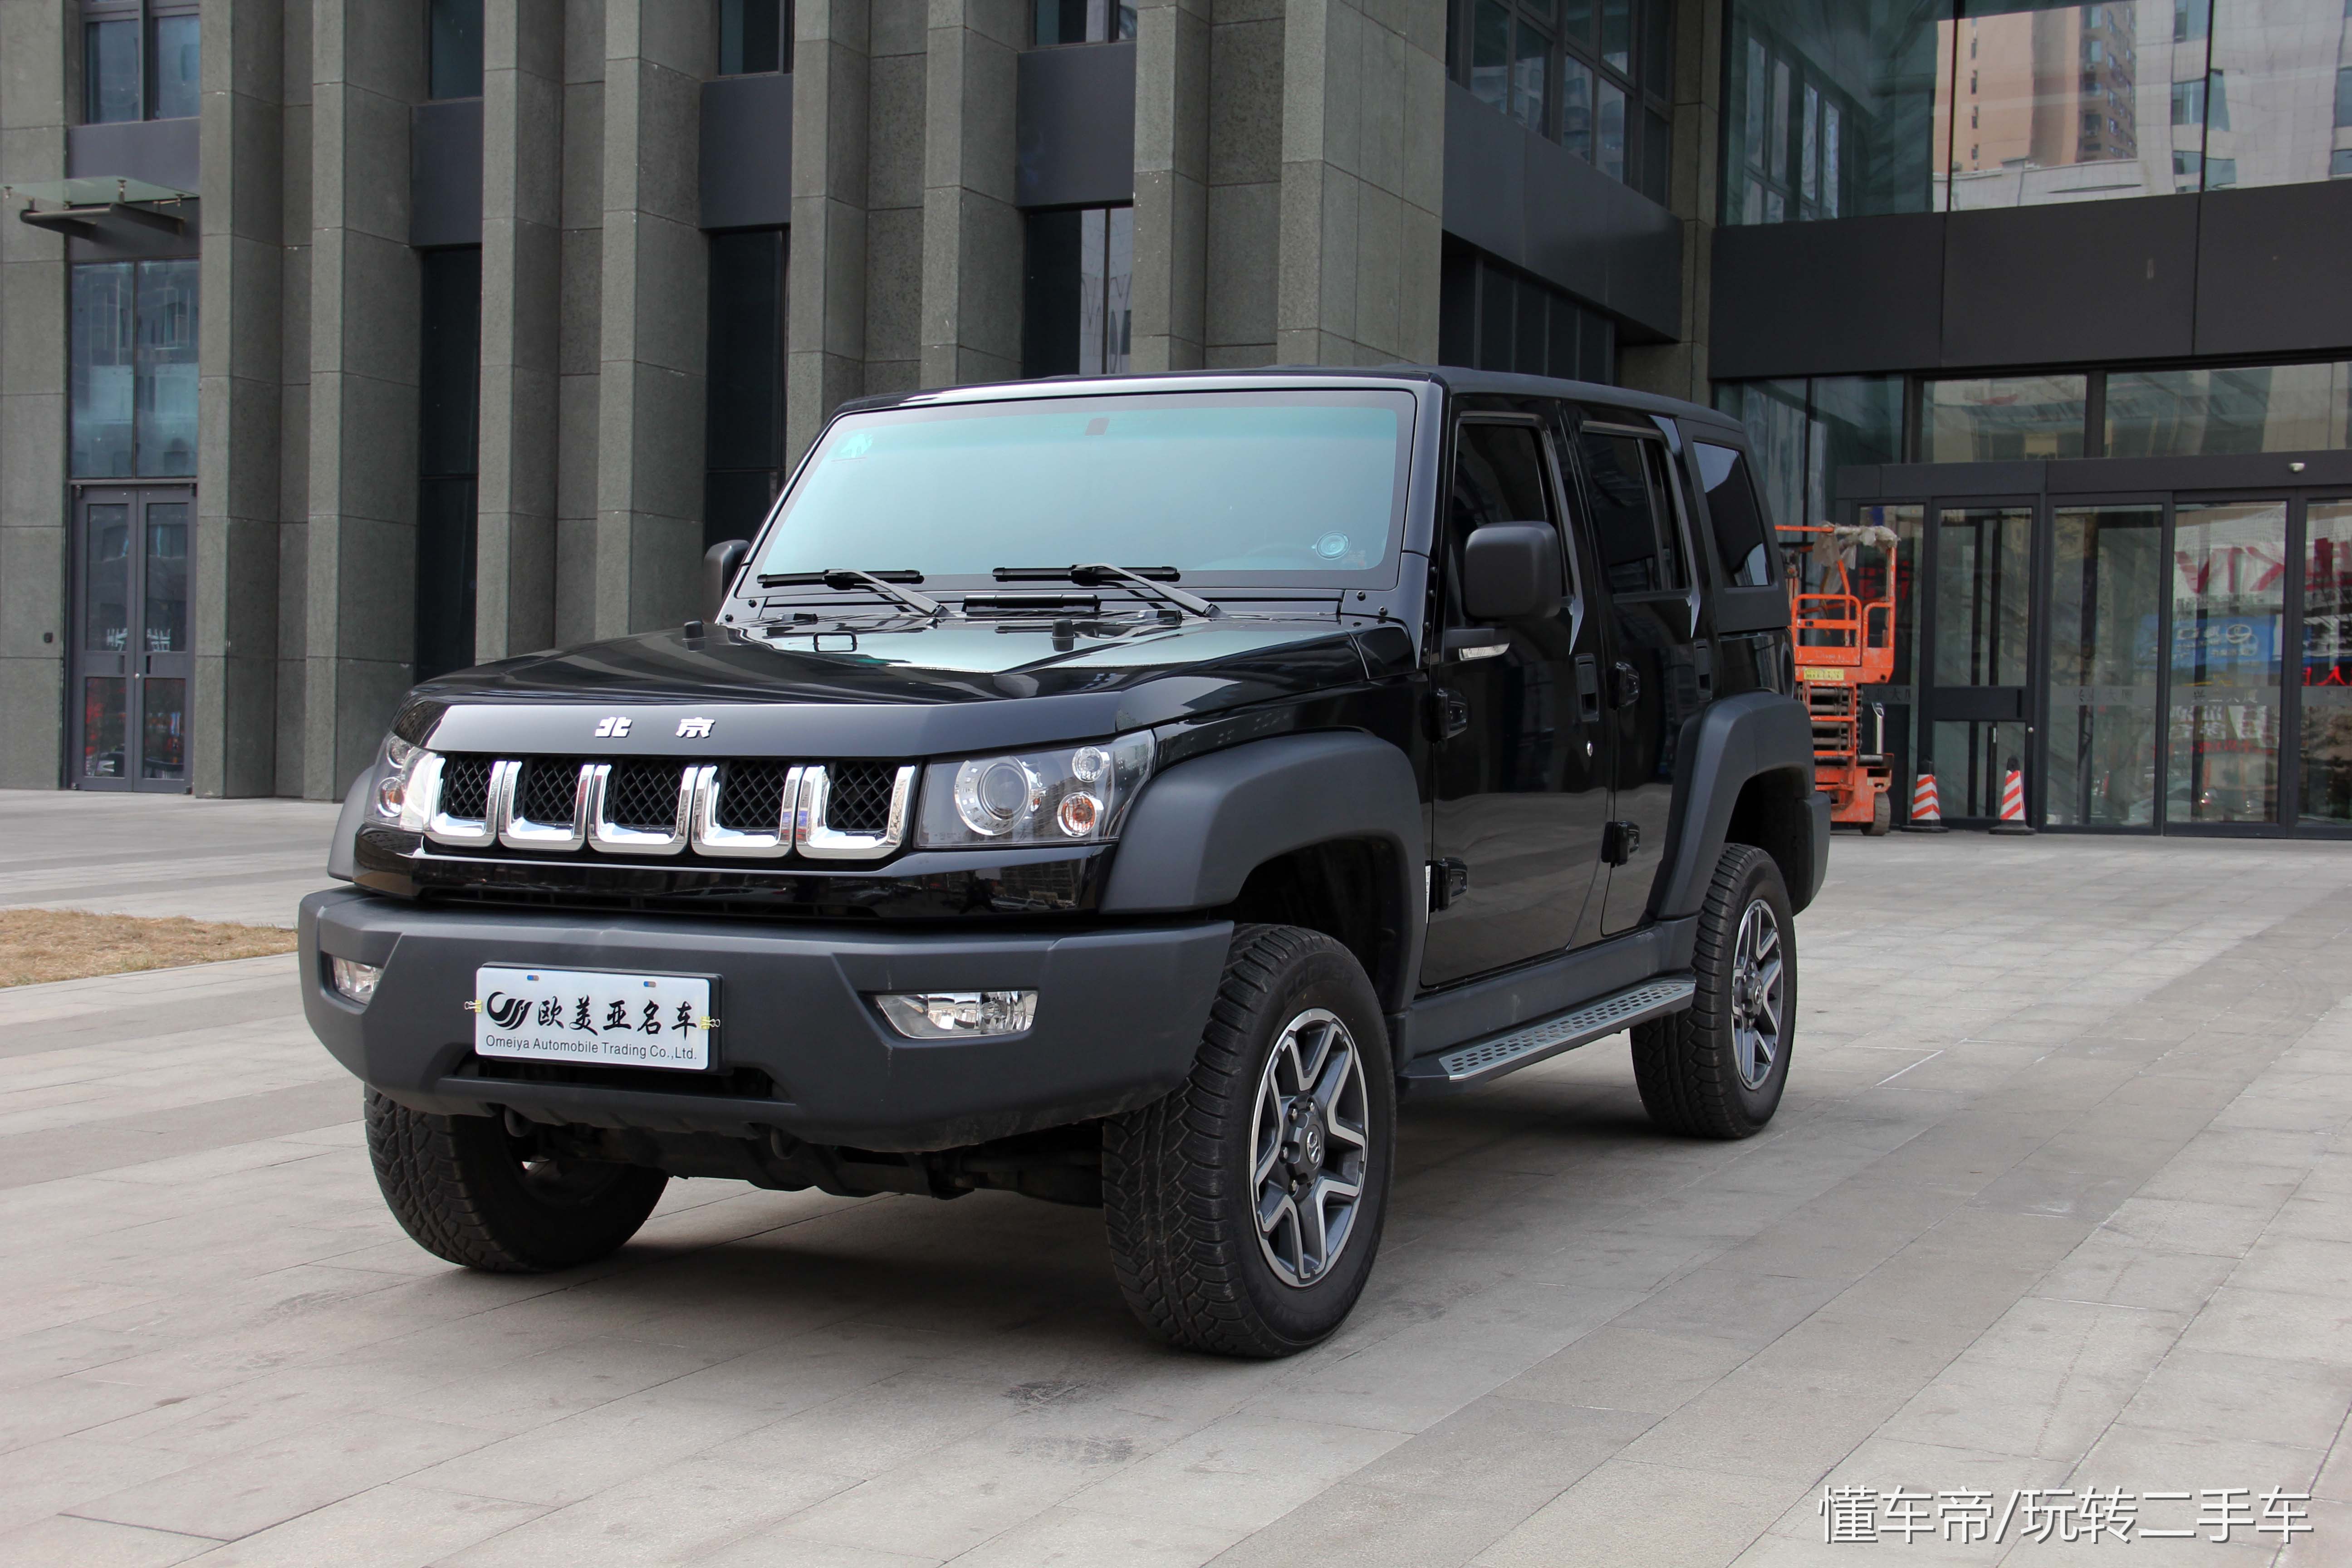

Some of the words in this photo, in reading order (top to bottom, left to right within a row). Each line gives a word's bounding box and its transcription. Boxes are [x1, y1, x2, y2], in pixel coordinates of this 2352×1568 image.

[595, 716, 715, 738] 北京
[538, 995, 697, 1040] 欧美亚名车
[486, 1035, 530, 1050] Omeiya
[533, 1036, 598, 1053] Automobile
[602, 1042, 646, 1058] Trading
[650, 1044, 697, 1060] Co.,Ltd.
